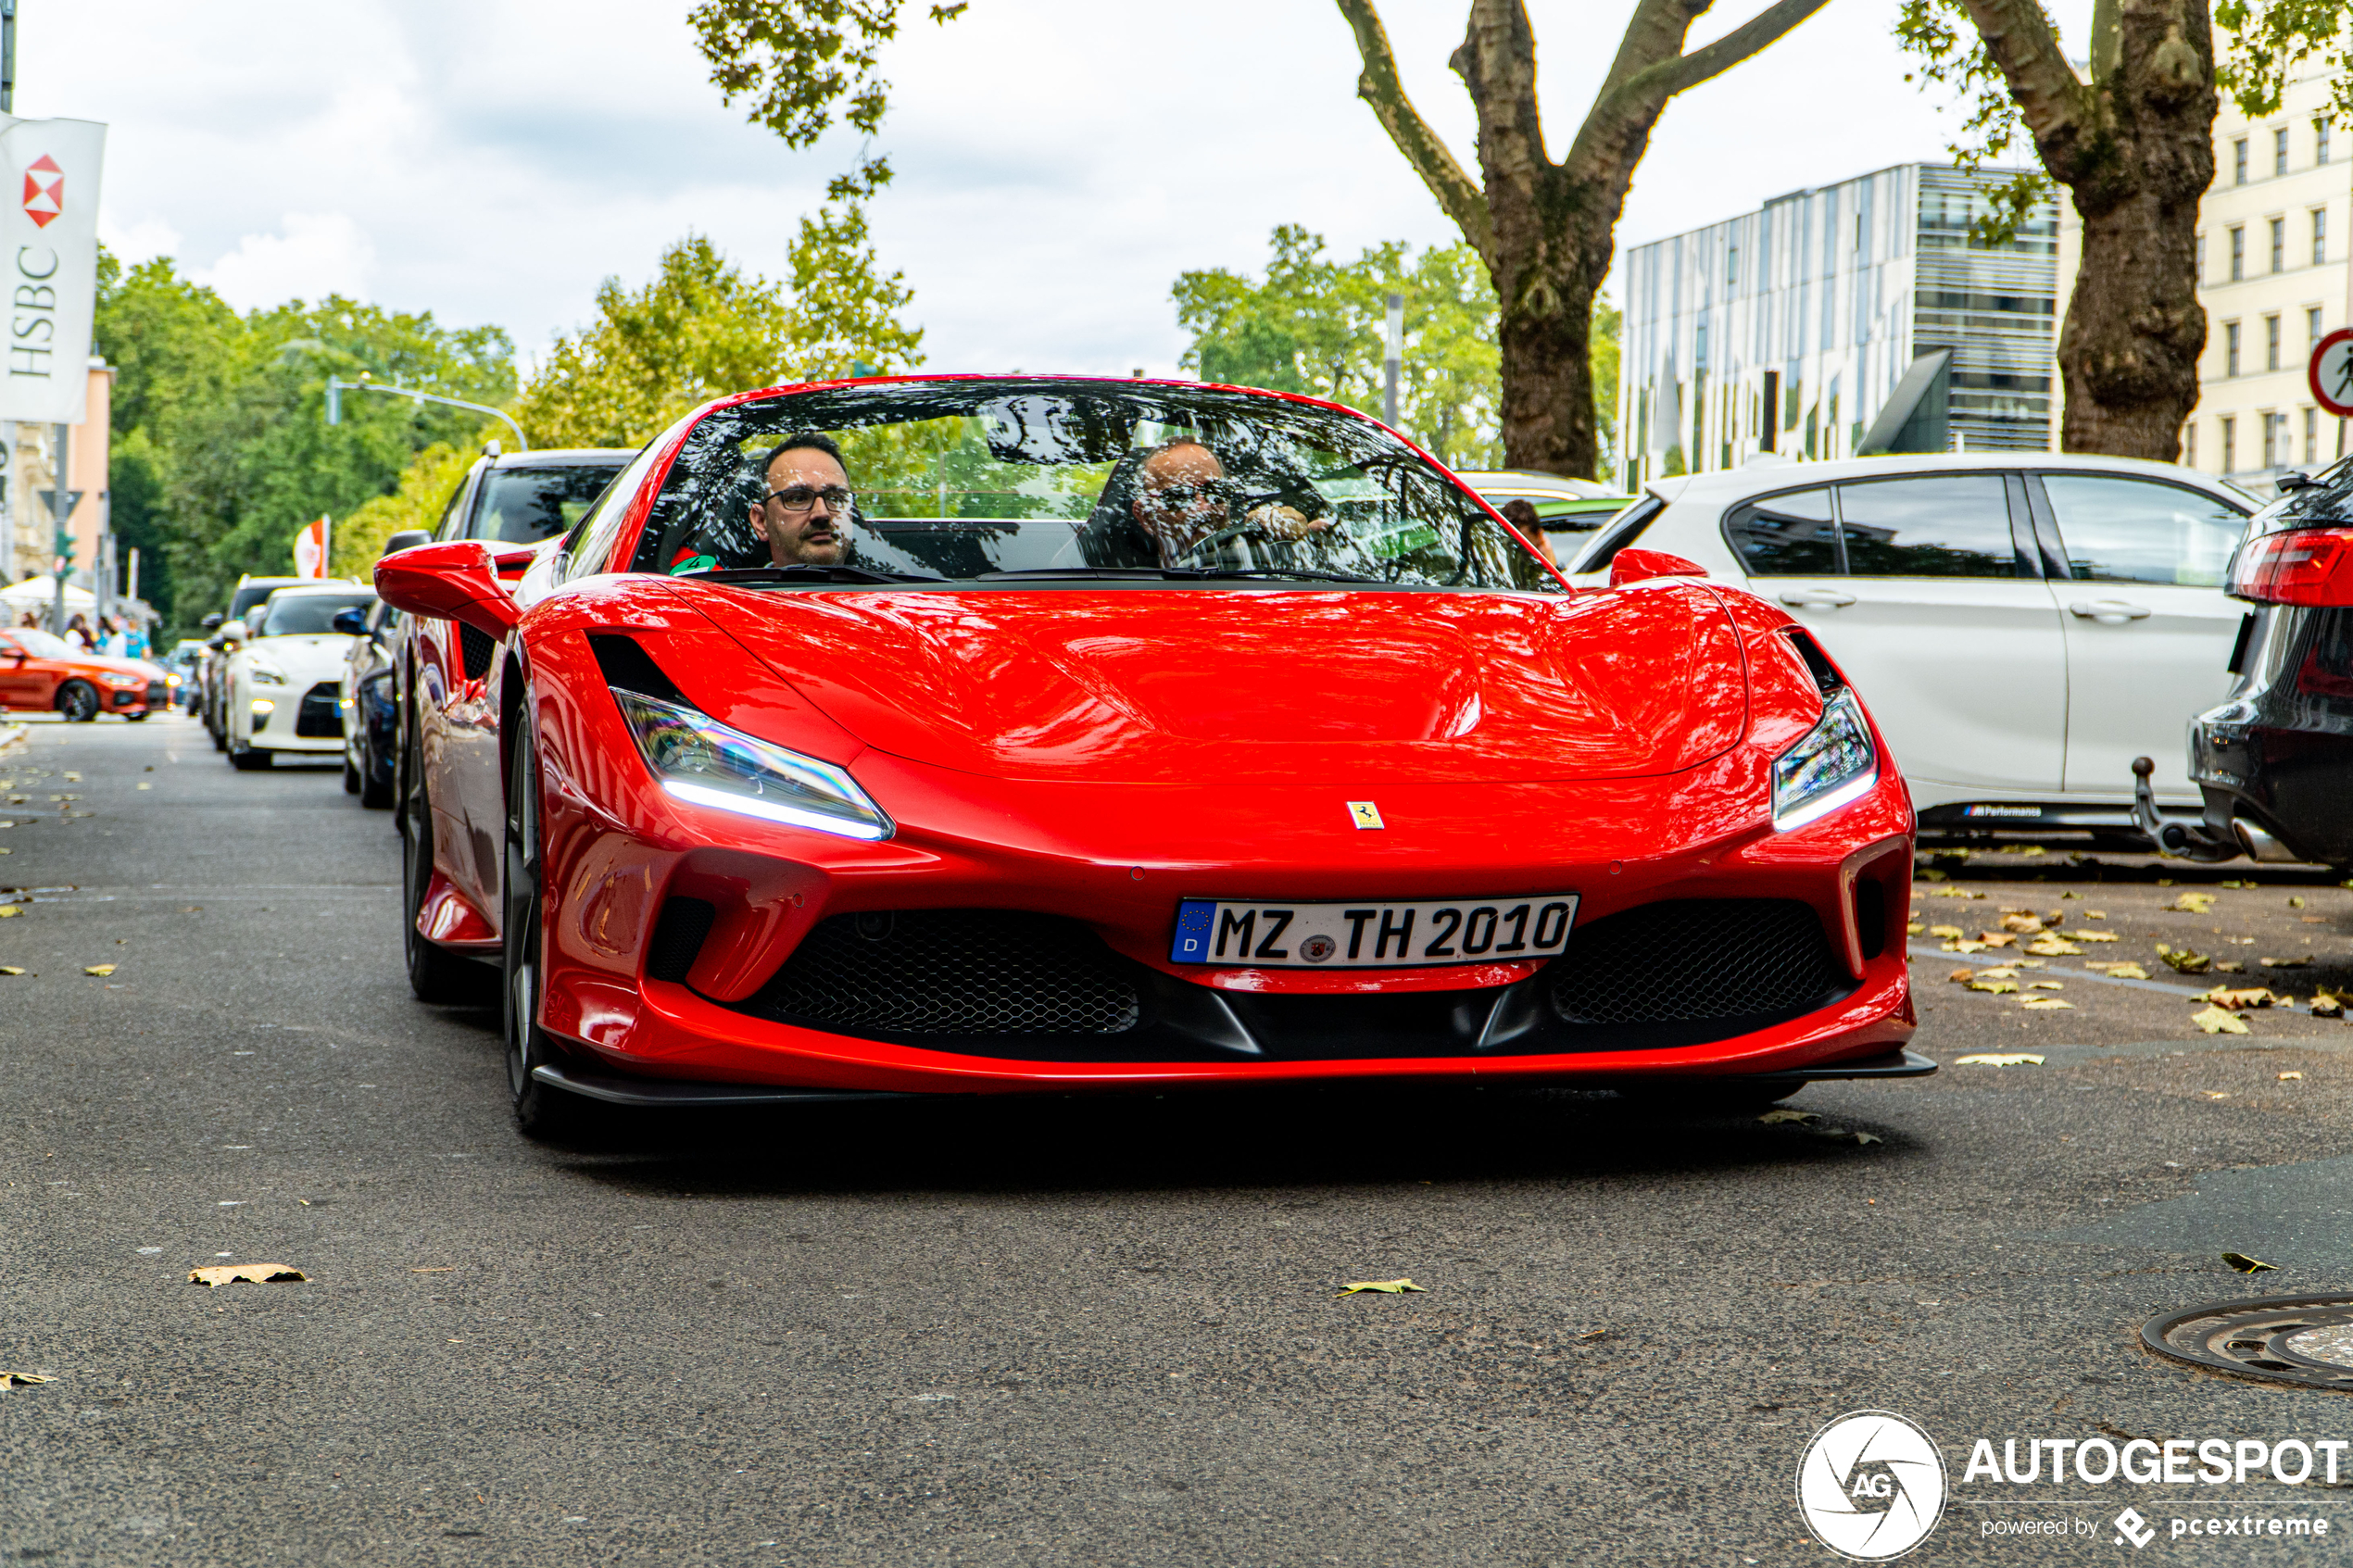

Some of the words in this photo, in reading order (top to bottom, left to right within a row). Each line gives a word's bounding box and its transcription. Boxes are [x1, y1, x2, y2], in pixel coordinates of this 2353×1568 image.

[10, 245, 57, 377] HSBC
[686, 556, 700, 569] 4
[1985, 805, 2041, 817] Performance
[1215, 909, 1294, 959] MZ
[1344, 909, 1416, 959] TH
[1425, 902, 1569, 956] 2010
[1184, 939, 1198, 952] D
